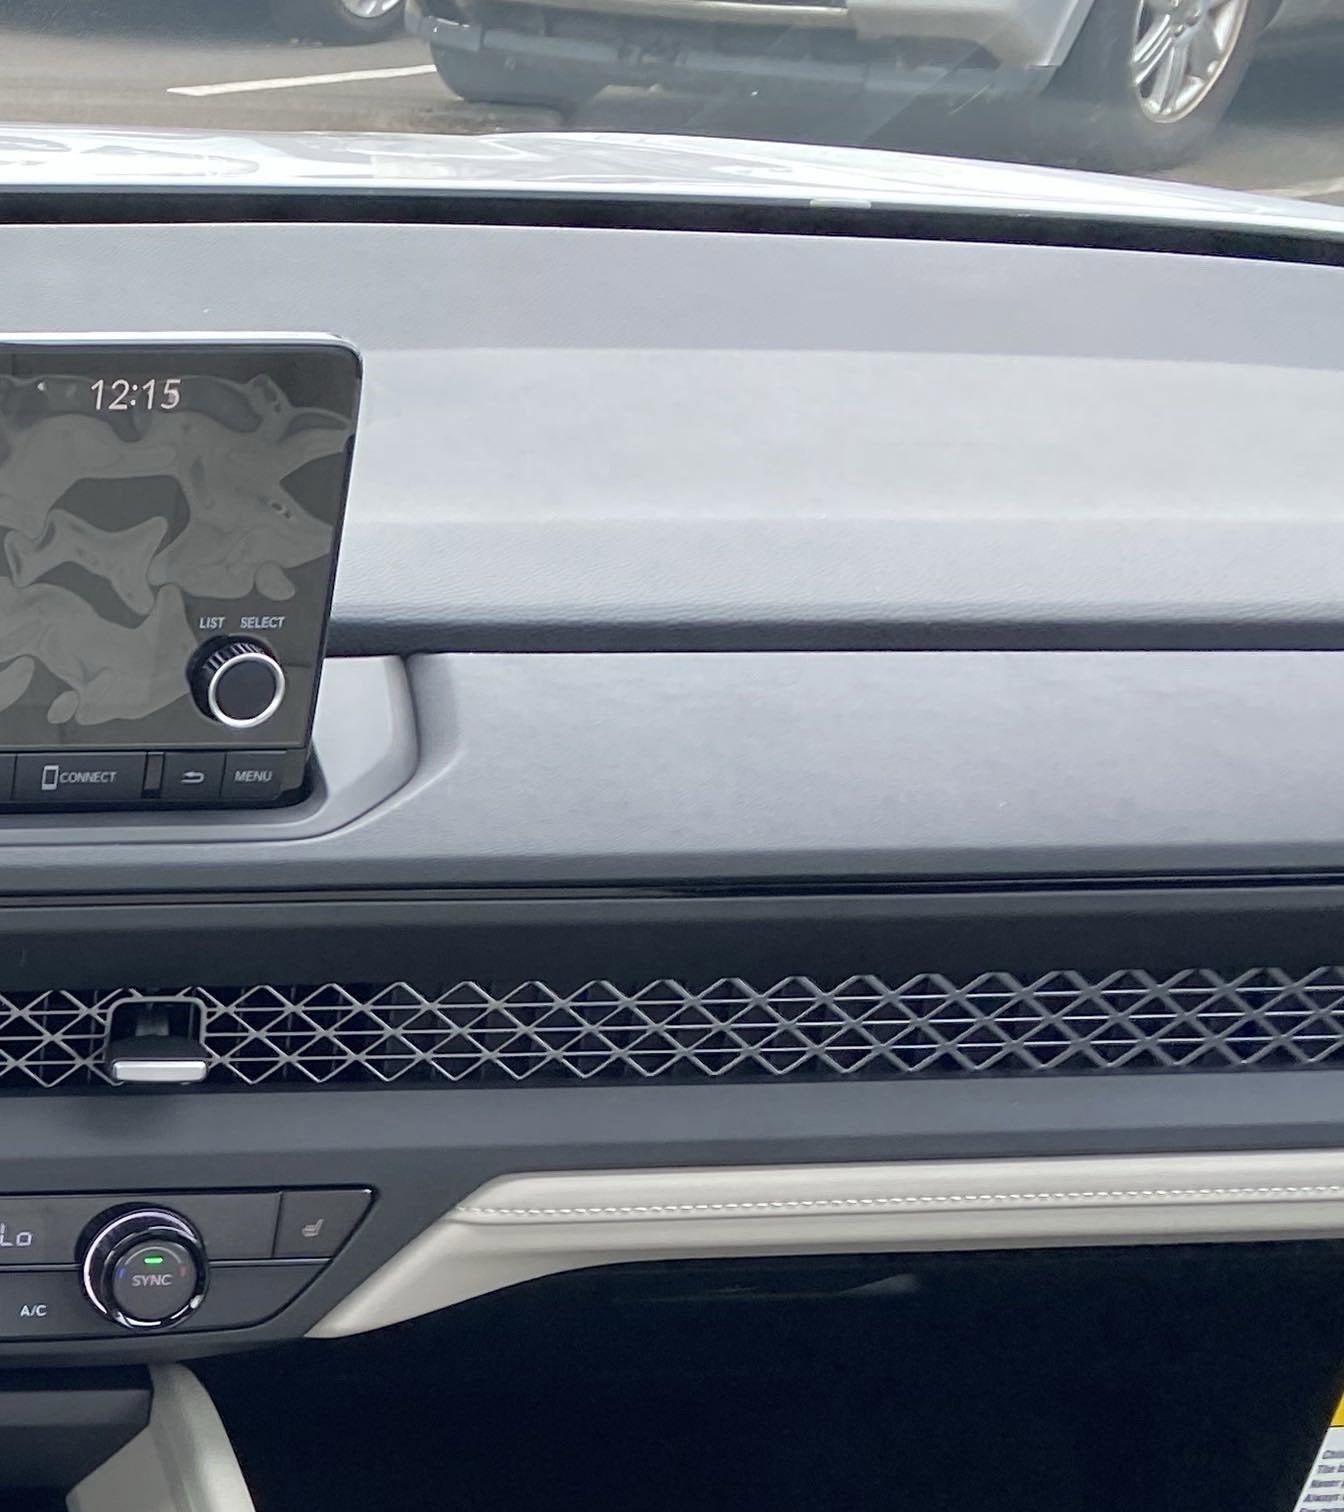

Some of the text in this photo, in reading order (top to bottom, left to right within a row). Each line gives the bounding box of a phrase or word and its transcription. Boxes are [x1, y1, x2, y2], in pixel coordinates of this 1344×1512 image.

[90, 377, 182, 412] 12:15
[198, 615, 226, 630] LIST
[239, 615, 286, 630] SELECT
[59, 770, 118, 784] CONNECT
[234, 769, 274, 783] MENU
[131, 1273, 173, 1288] SYNC
[19, 1304, 48, 1318] A/C
